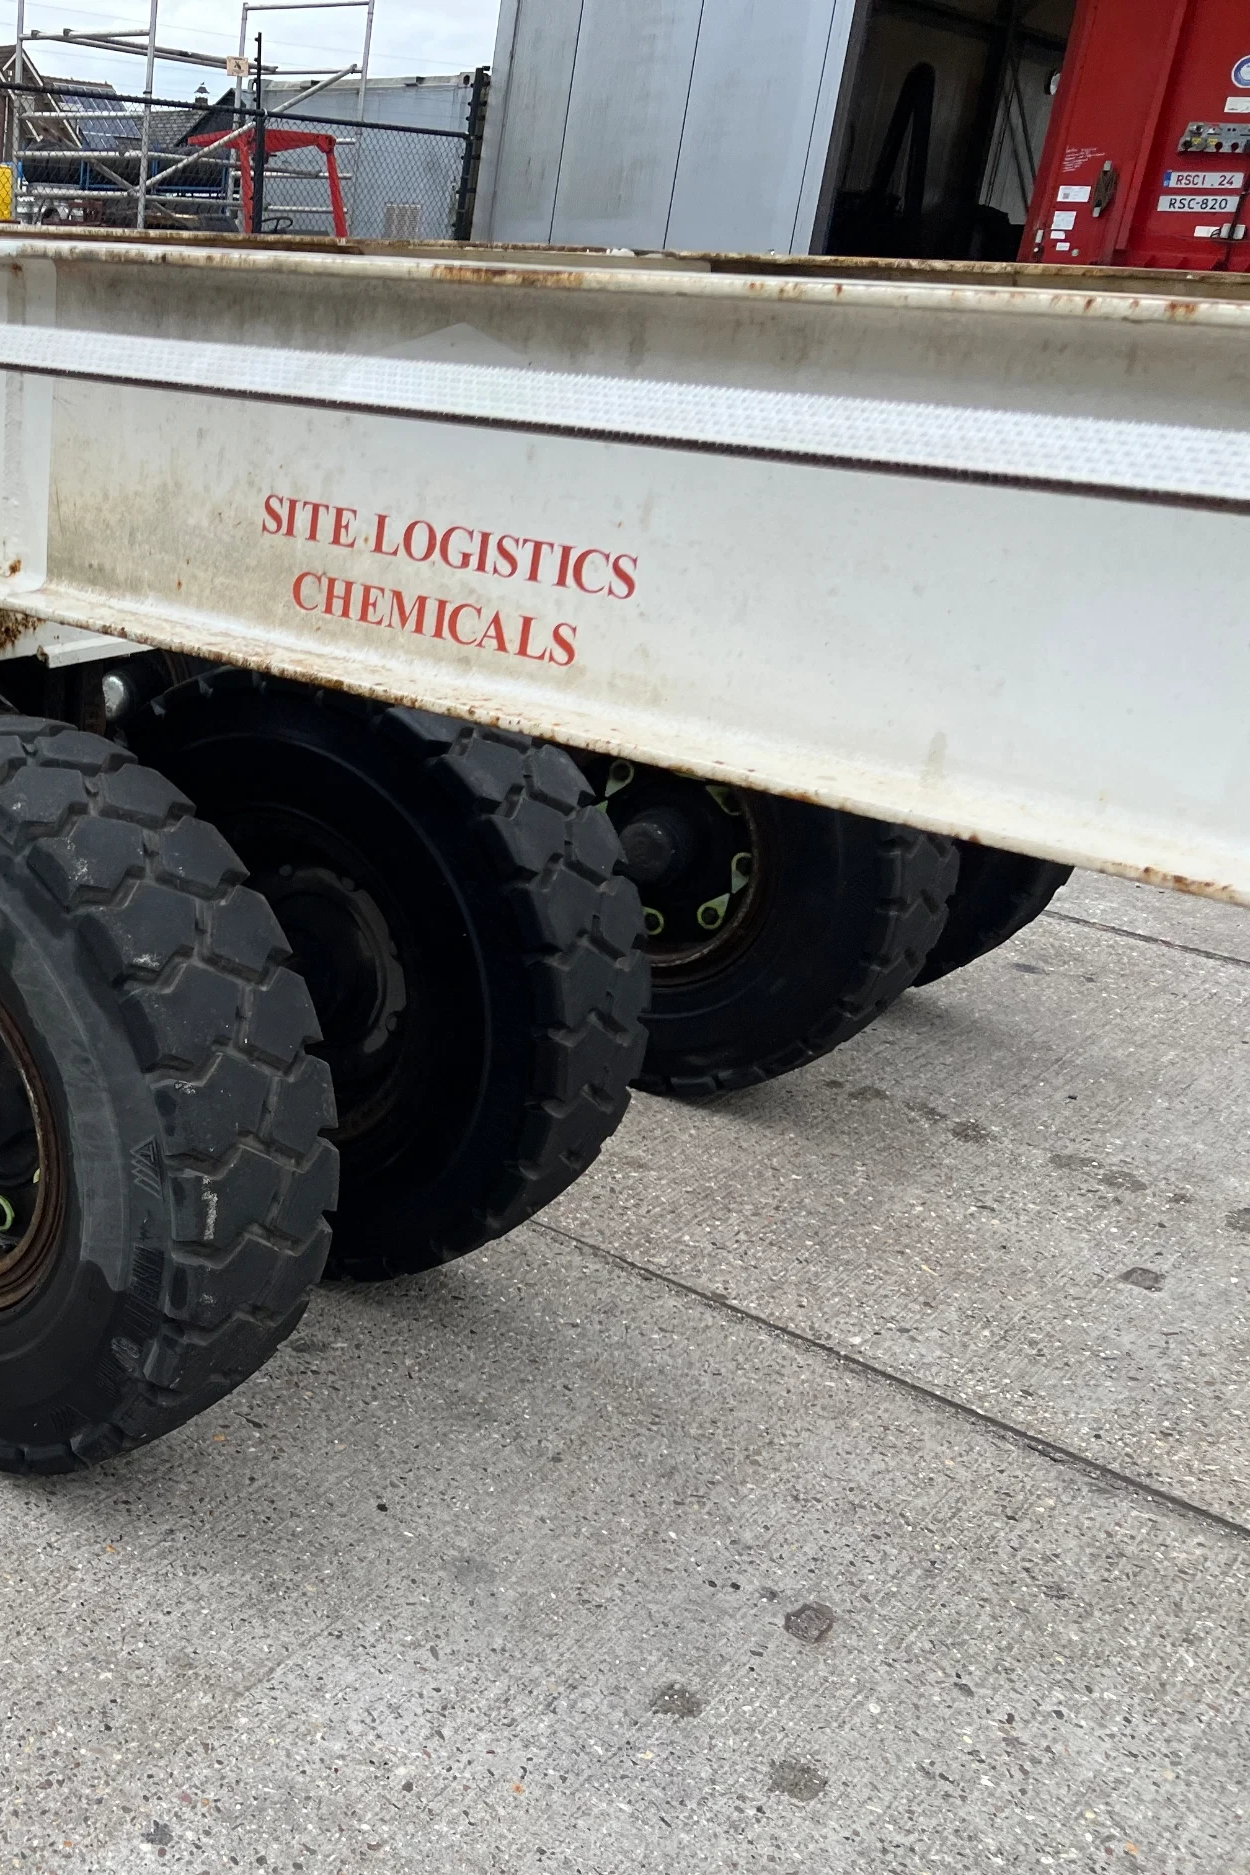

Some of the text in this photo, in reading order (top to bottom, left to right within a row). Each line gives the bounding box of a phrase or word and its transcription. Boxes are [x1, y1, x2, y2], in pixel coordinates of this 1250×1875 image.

[1168, 197, 1228, 210] RSC-820
[1218, 174, 1235, 186] 24
[262, 494, 639, 600] SITE LOGISTICS
[292, 571, 578, 667] CHEMICALS
